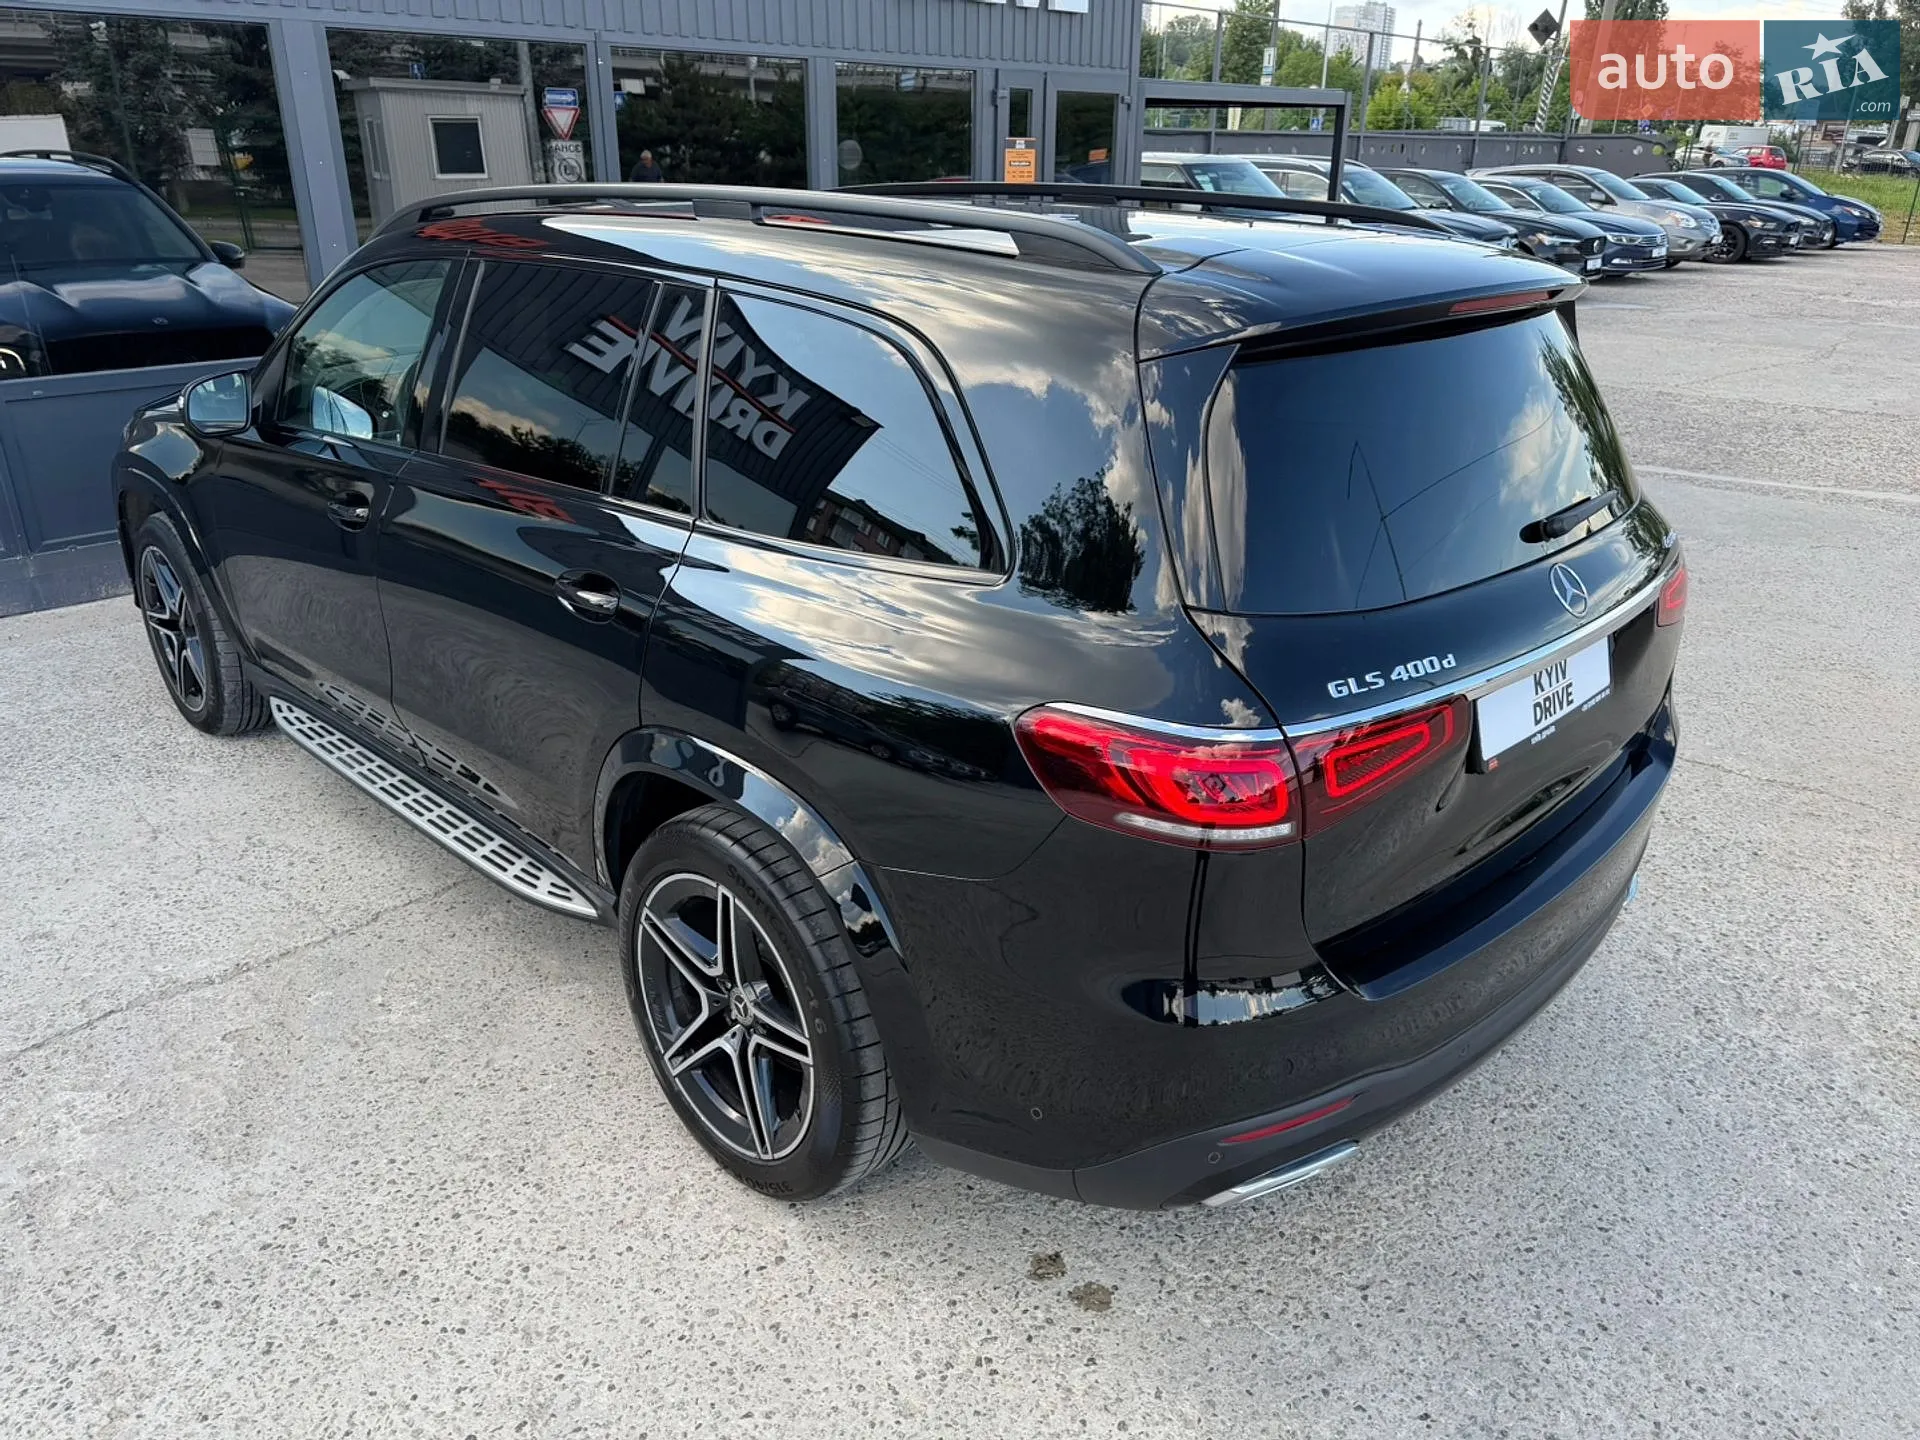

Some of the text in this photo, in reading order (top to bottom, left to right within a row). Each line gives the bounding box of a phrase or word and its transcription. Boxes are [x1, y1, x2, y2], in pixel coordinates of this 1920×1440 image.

[1327, 671, 1386, 699] GLS
[1533, 659, 1567, 695] KYIV
[1533, 682, 1575, 726] DRIVE
